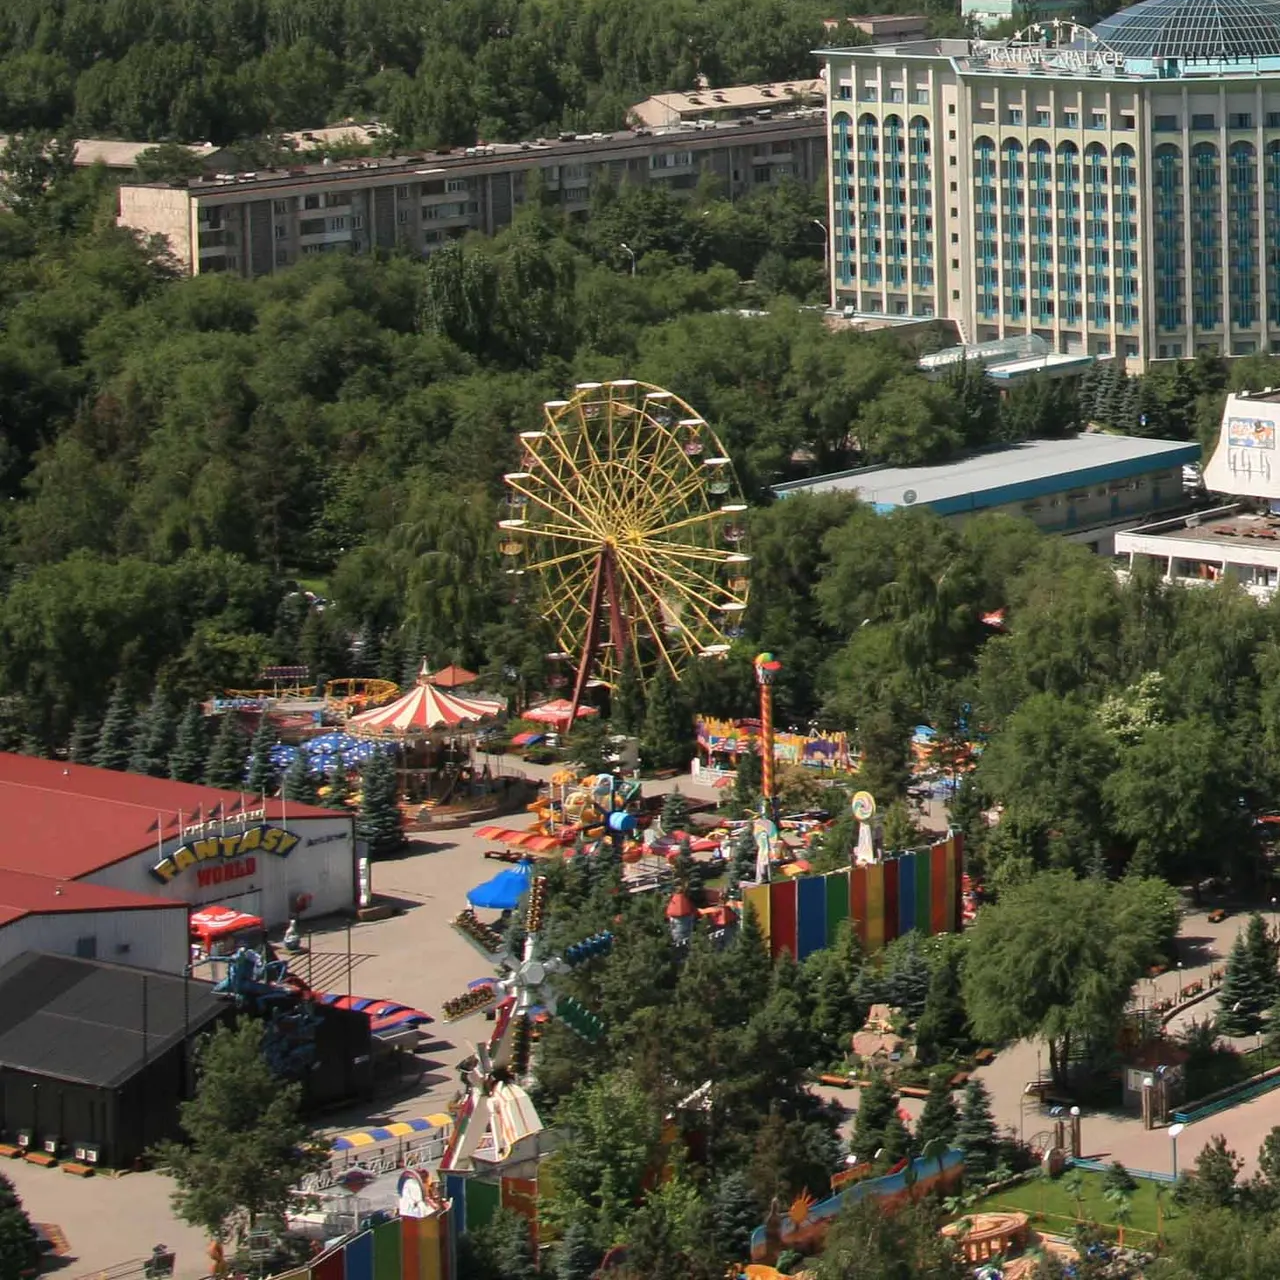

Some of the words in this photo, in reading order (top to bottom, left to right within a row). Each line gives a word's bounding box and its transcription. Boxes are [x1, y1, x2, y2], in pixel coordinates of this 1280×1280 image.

[989, 47, 1042, 64] RAHAT
[1065, 51, 1125, 67] PALACE
[154, 827, 298, 880] FANTASY
[197, 857, 256, 887] WORLD
